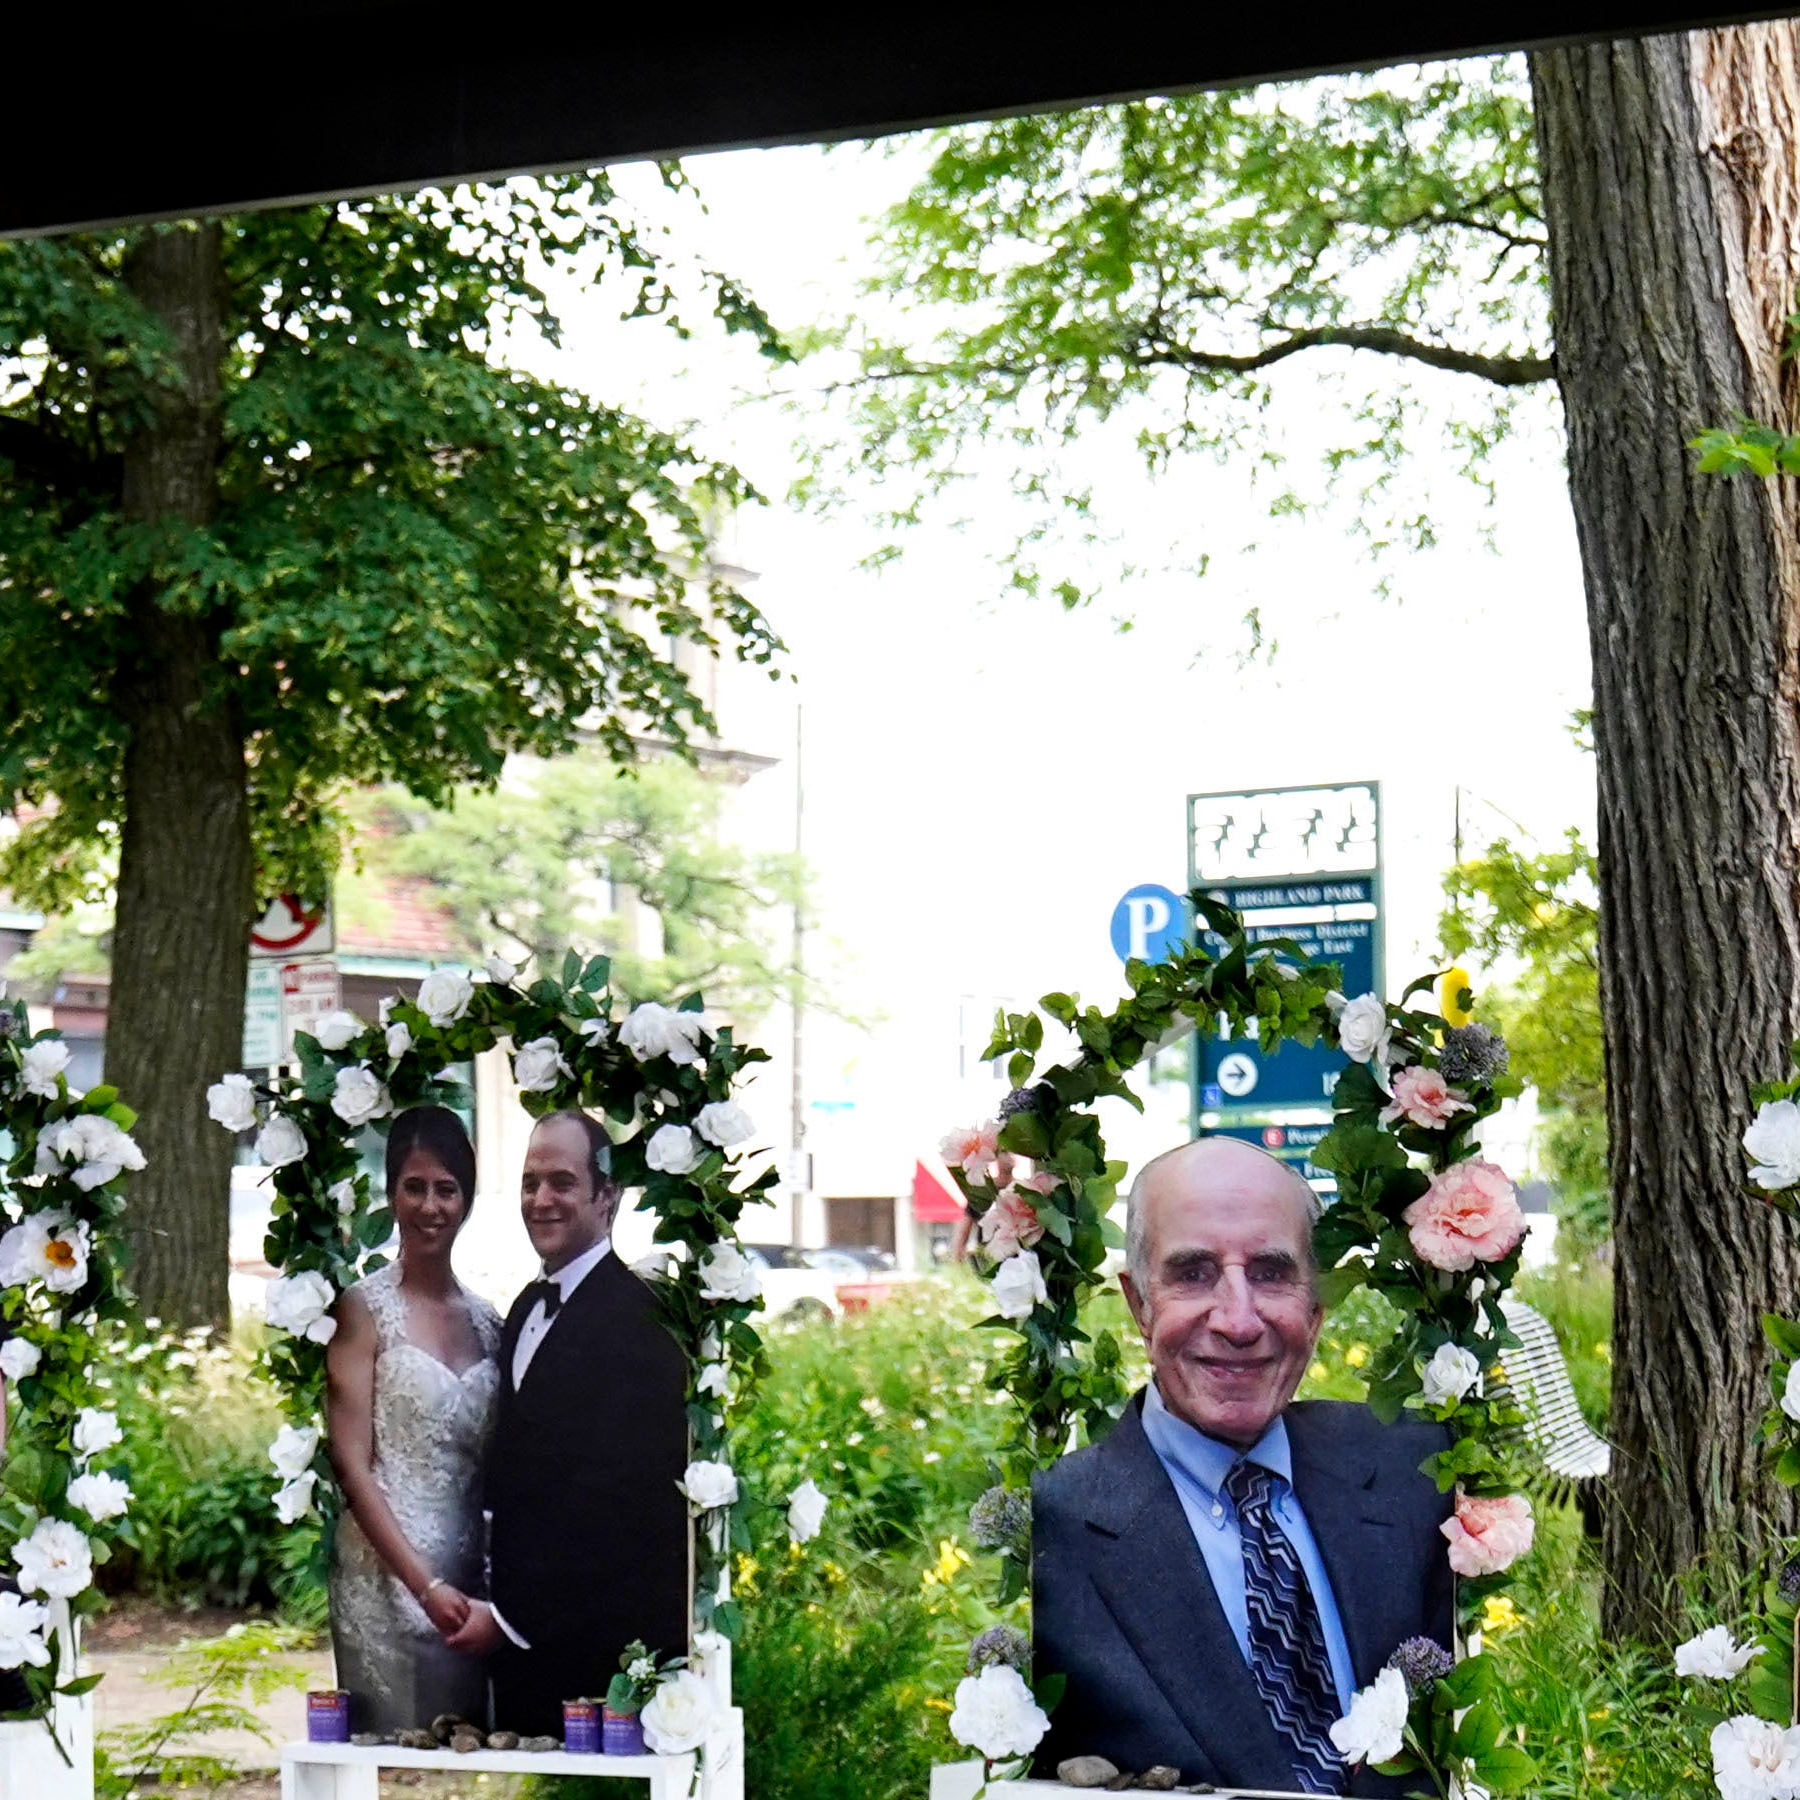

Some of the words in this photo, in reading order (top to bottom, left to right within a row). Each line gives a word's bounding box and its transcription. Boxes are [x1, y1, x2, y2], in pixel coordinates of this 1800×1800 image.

[1234, 886, 1322, 908] HIGHLAND
[1323, 883, 1365, 901] PARK
[1124, 896, 1170, 960] P
[1315, 922, 1369, 939] District
